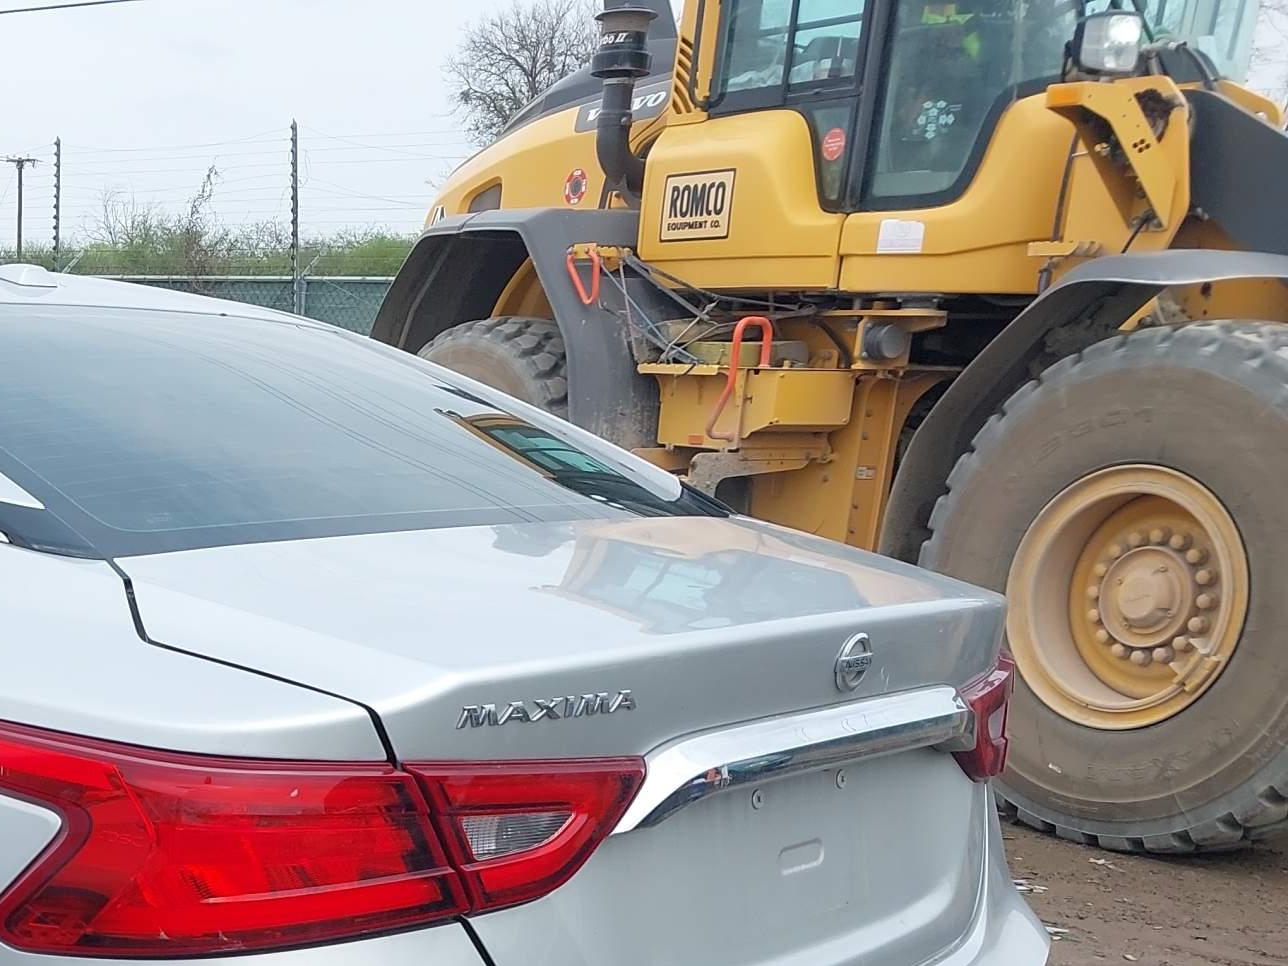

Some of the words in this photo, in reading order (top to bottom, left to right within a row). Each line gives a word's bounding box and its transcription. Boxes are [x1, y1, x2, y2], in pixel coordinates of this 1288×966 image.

[587, 91, 666, 121] VVO
[669, 181, 726, 218] ROMCO
[667, 220, 707, 231] EQUIPMENT
[710, 220, 720, 228] CO.
[844, 656, 872, 669] NISSAN
[456, 690, 636, 729] MAXIMA
